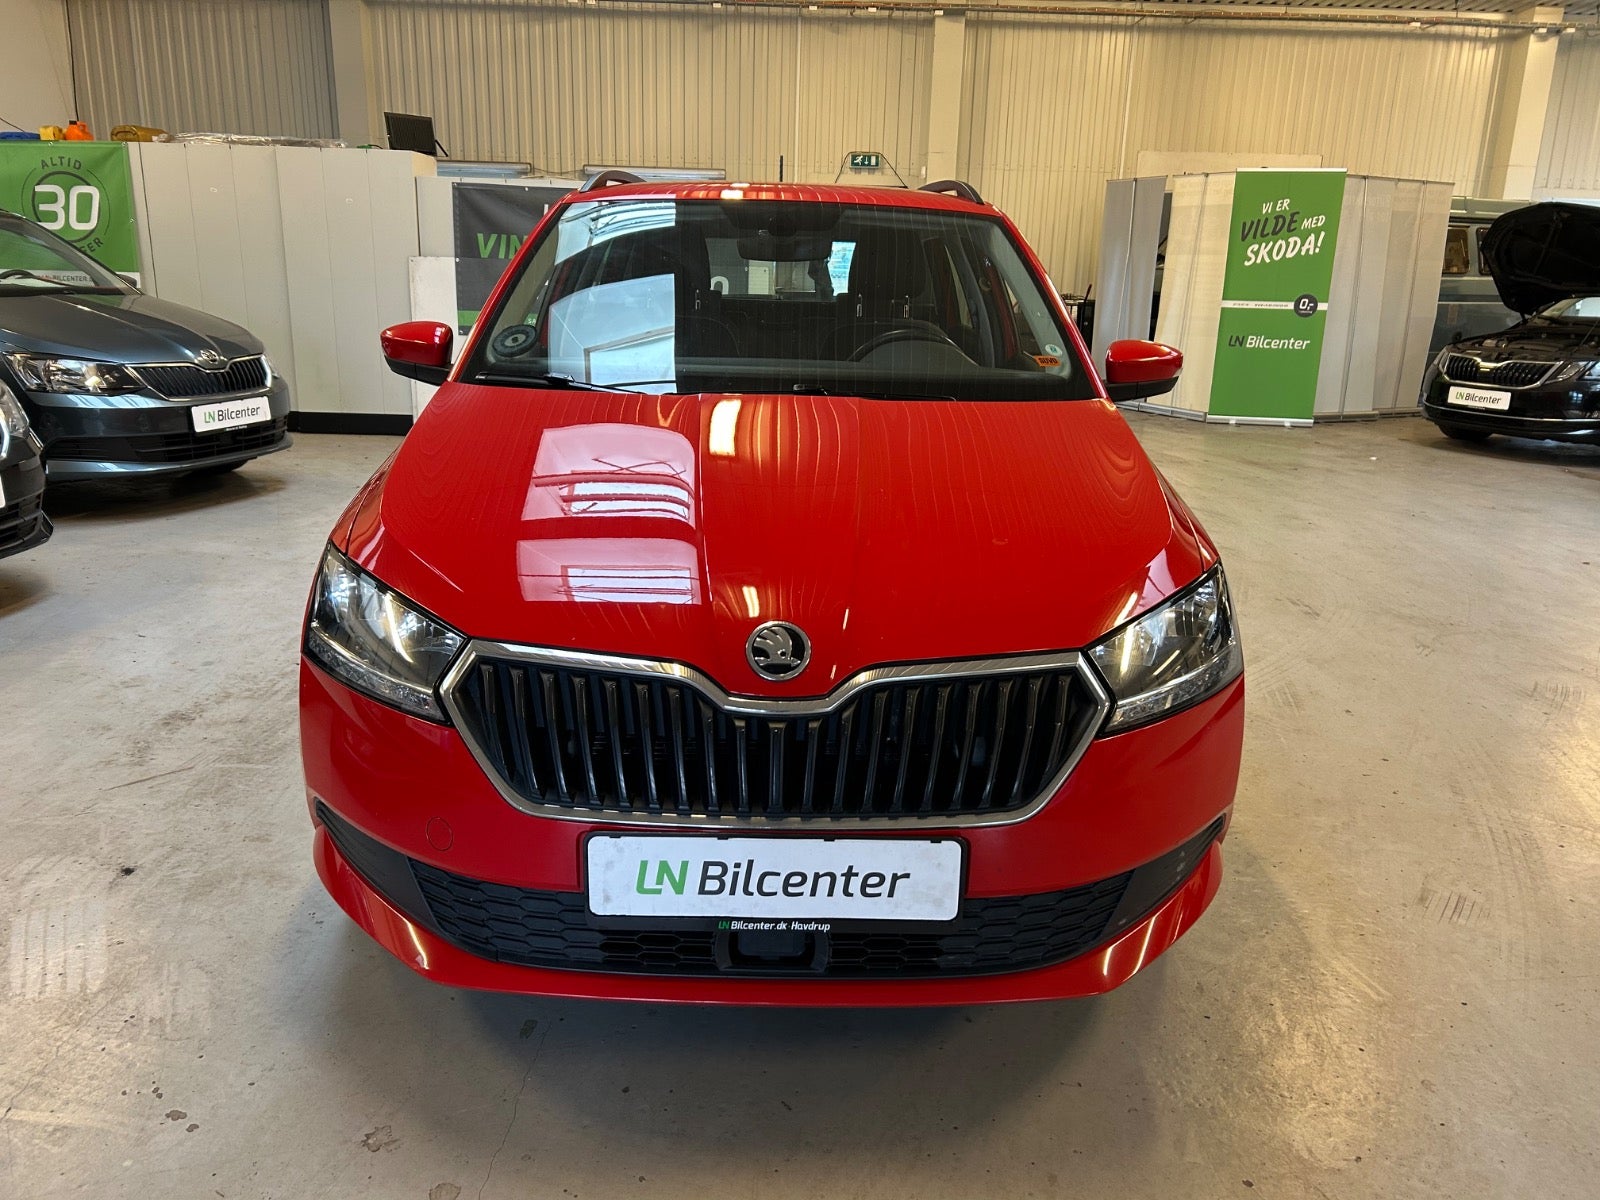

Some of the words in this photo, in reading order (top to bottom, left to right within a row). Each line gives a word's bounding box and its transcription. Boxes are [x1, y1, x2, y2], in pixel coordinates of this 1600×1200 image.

[41, 156, 82, 170] ALTID
[34, 184, 100, 230] 30
[1262, 202, 1273, 214] VI
[1276, 198, 1290, 211] ER
[1241, 211, 1300, 241] VILDE
[1301, 215, 1325, 229] MED
[477, 233, 528, 259] VIN
[1244, 231, 1325, 266] SKODA!
[1228, 335, 1245, 347] LN
[1246, 335, 1310, 349] Bilcenter
[1456, 391, 1465, 400] LN
[1465, 392, 1502, 404] Bilcenter
[204, 410, 215, 423] LN
[217, 406, 260, 422] Bilcenter
[636, 859, 689, 895] LN
[697, 859, 911, 898] Bilcenter
[791, 921, 831, 932] Havdrup
